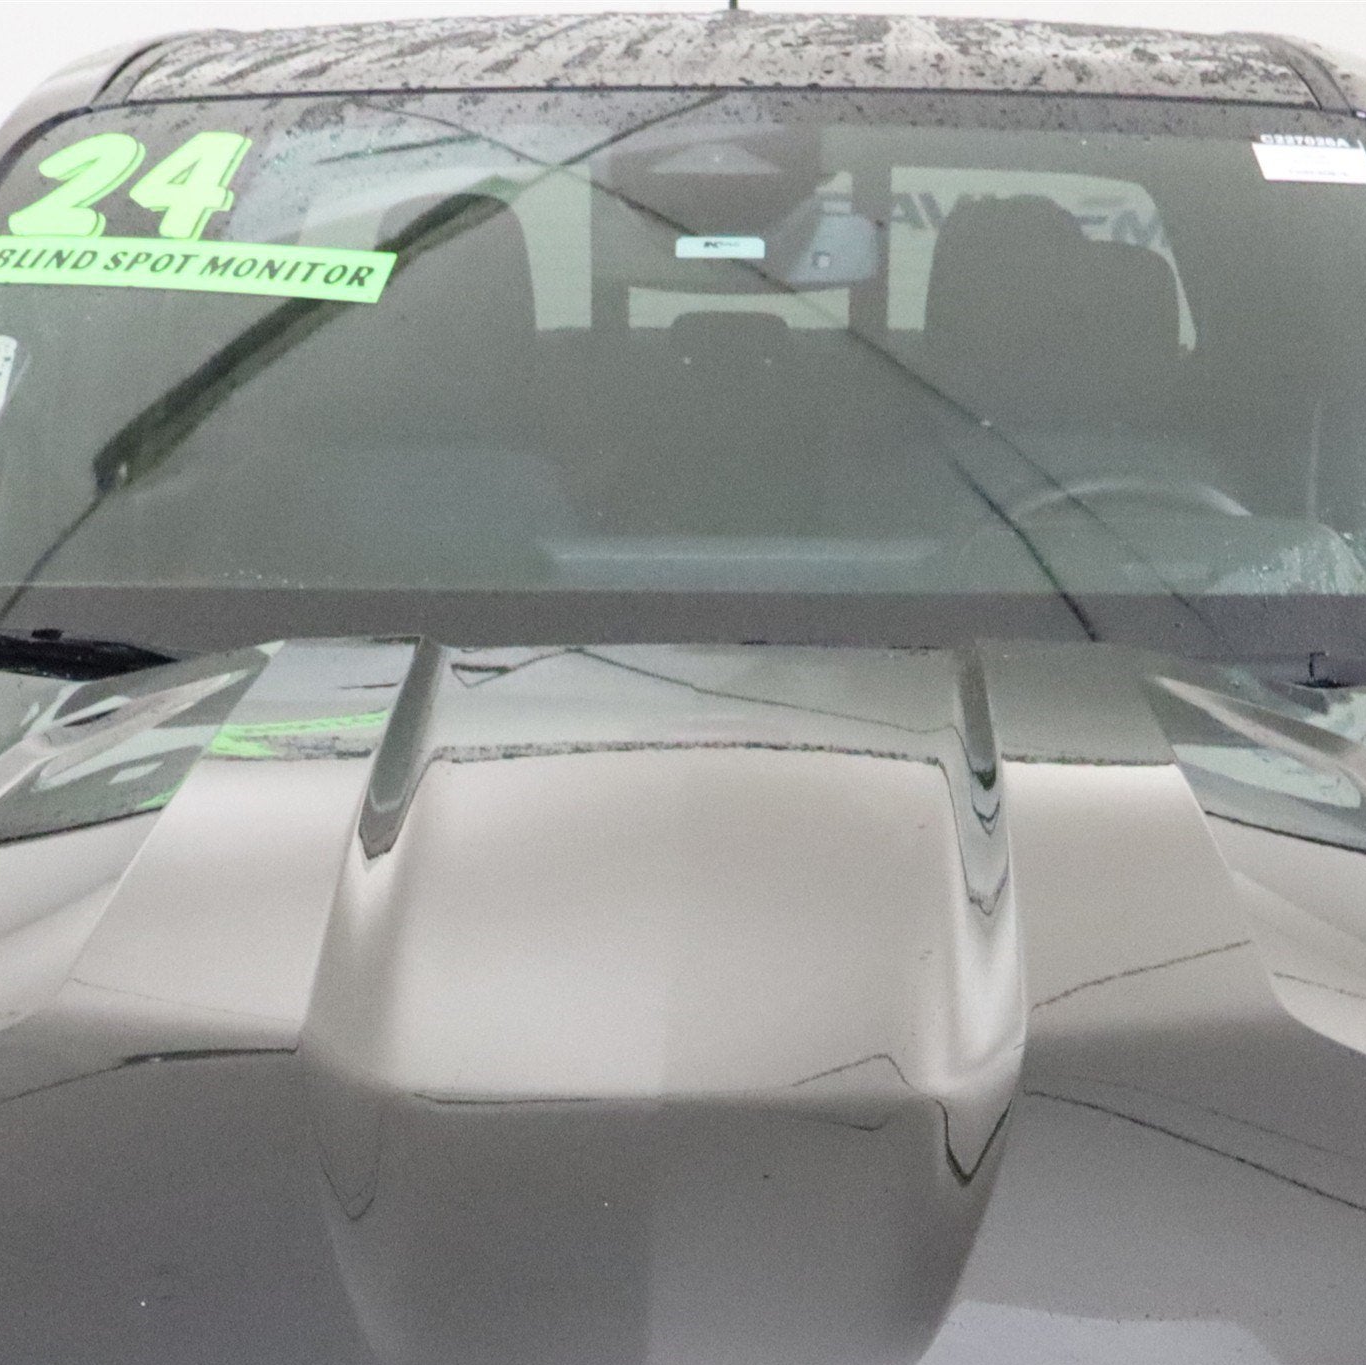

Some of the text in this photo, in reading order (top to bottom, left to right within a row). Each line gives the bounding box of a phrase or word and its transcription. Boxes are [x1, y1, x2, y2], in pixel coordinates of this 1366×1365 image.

[8, 131, 252, 241] 24
[104, 250, 199, 275] SPOT
[200, 255, 375, 289] MONITOR
